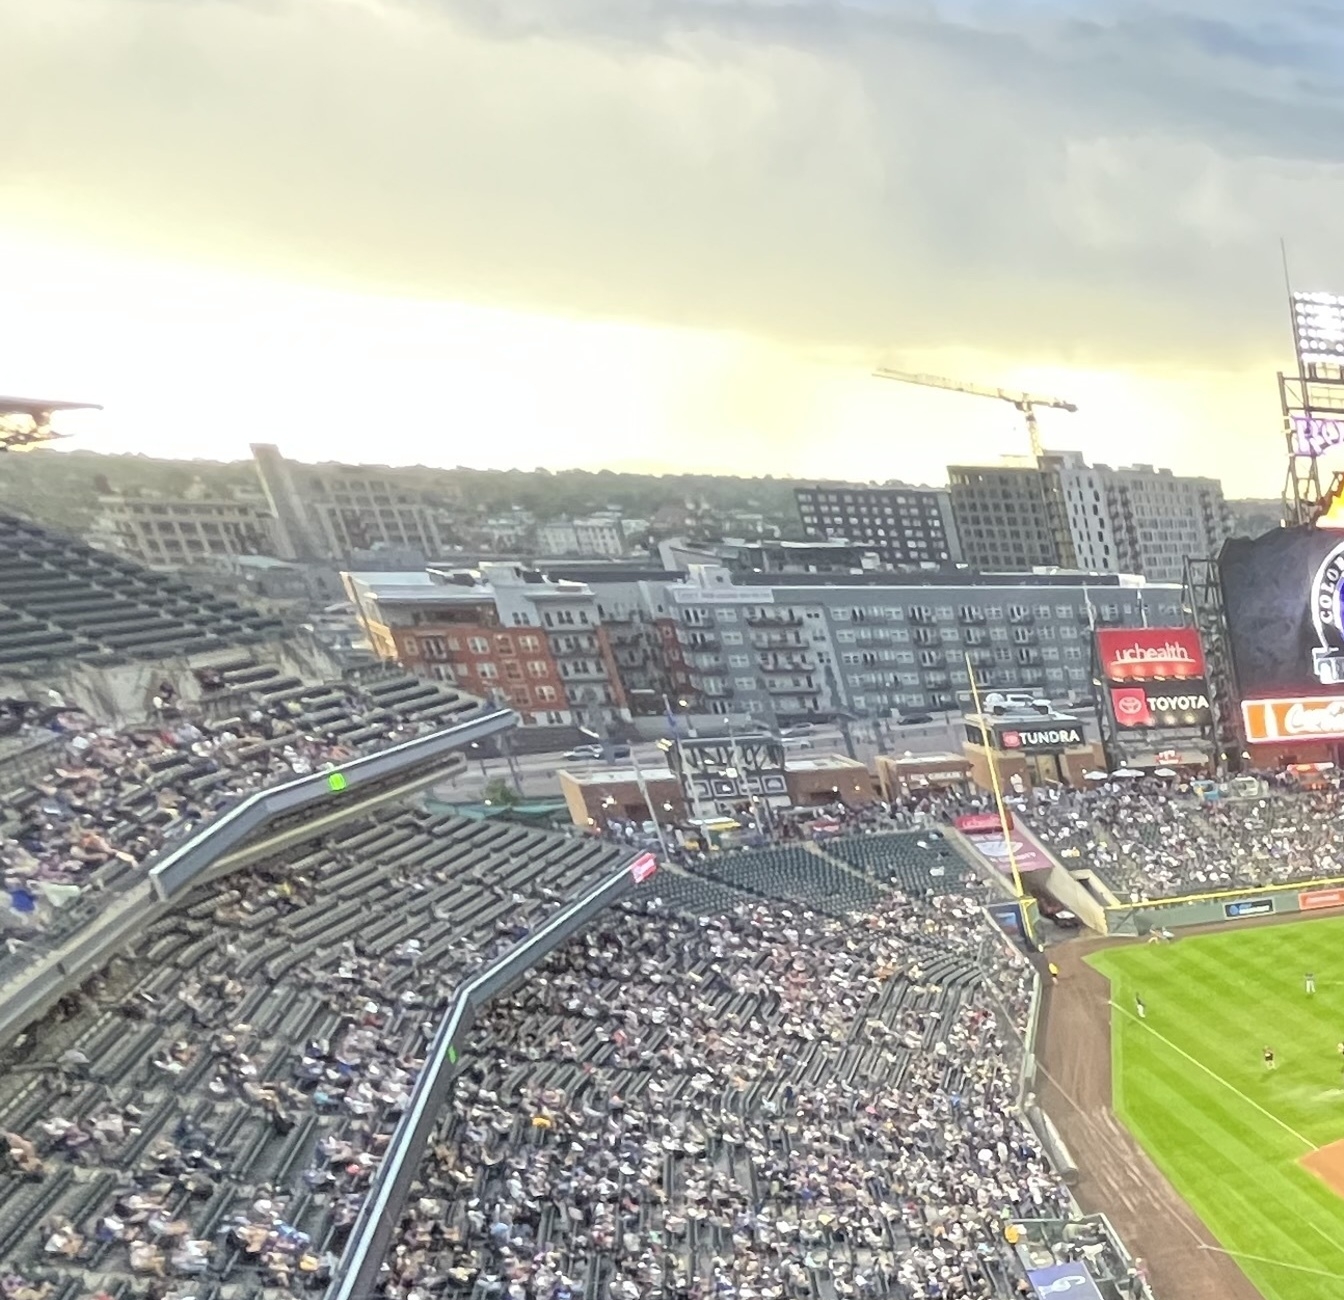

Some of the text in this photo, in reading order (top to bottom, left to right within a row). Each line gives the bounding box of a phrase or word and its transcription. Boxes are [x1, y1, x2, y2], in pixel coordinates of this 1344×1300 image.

[1116, 641, 1188, 661] uchealth
[1147, 695, 1209, 711] TOYOTA
[1019, 730, 1080, 745] TUNDRA
